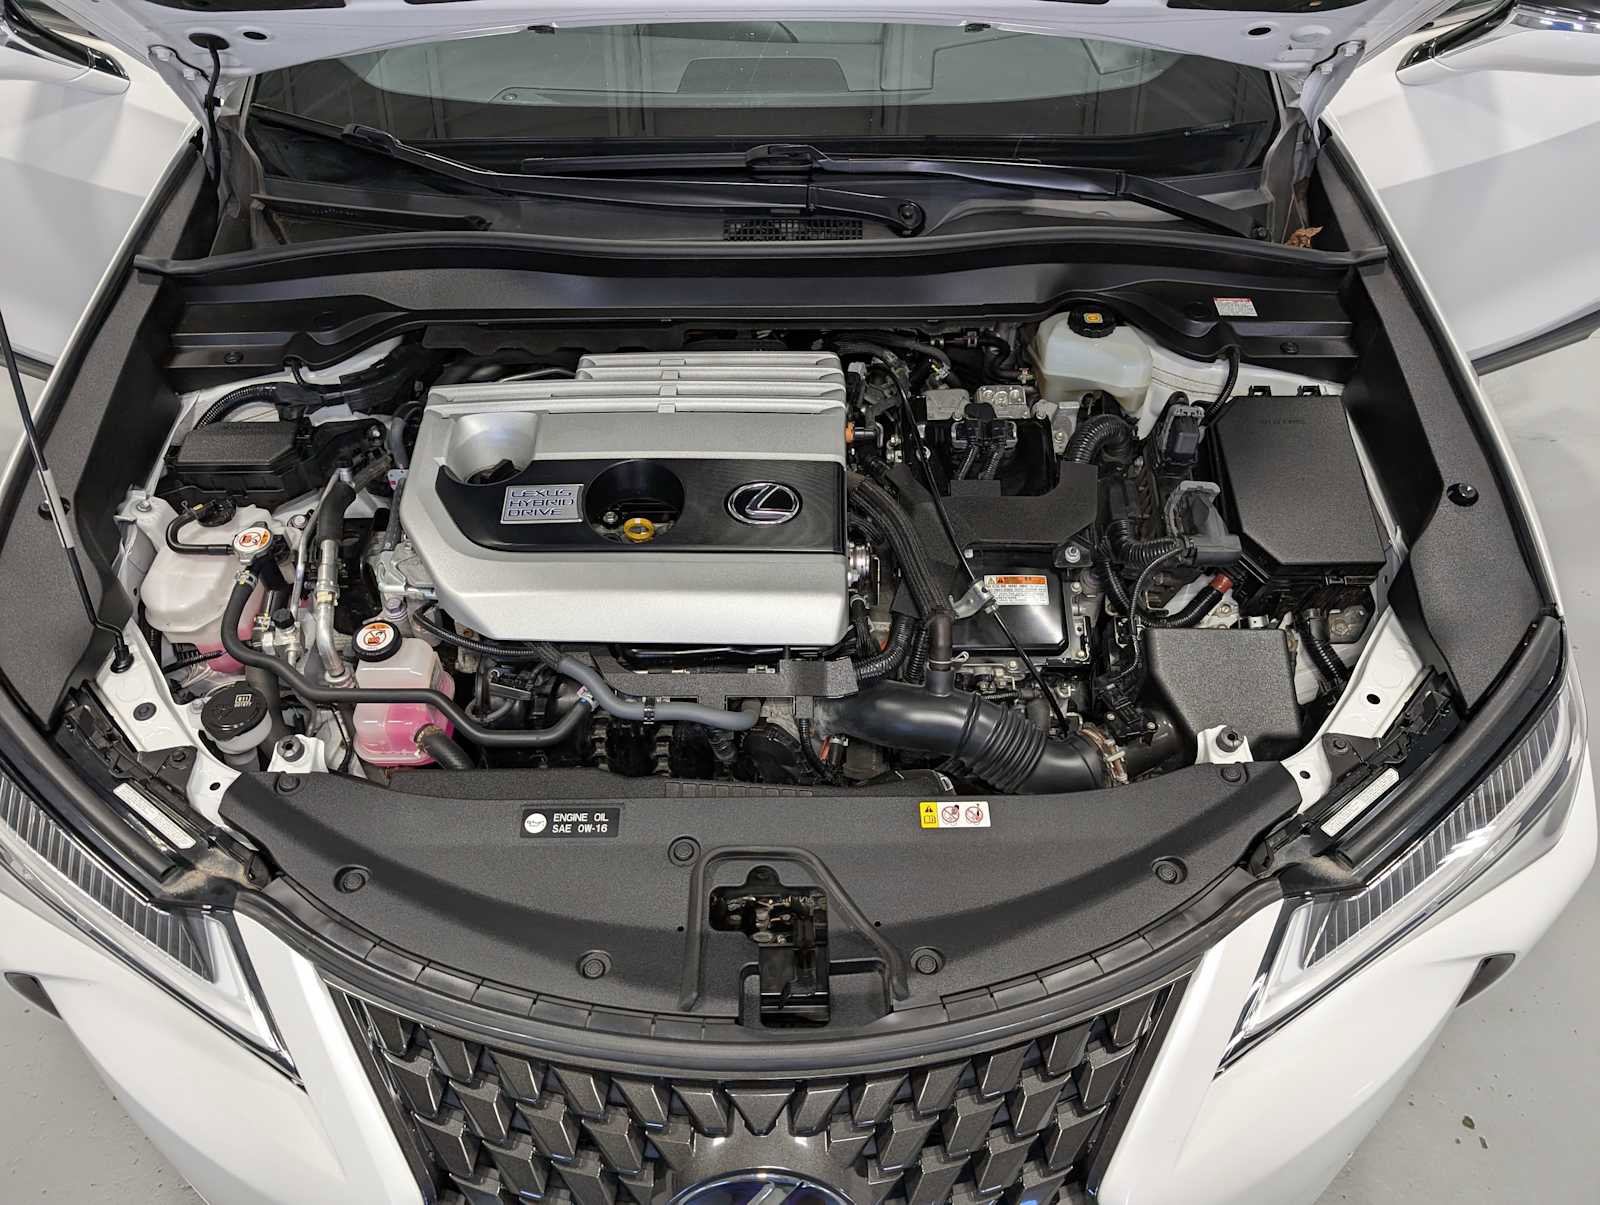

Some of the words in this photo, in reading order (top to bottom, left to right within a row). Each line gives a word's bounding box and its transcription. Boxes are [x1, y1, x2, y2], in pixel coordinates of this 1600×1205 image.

[511, 488, 573, 497] LEXUS
[509, 498, 574, 507] HYBRID
[508, 508, 561, 517] DRIVE
[553, 813, 588, 822] ENGINE
[593, 813, 609, 822] OIL
[551, 824, 572, 833] SAE
[577, 824, 608, 833] 0W-16
